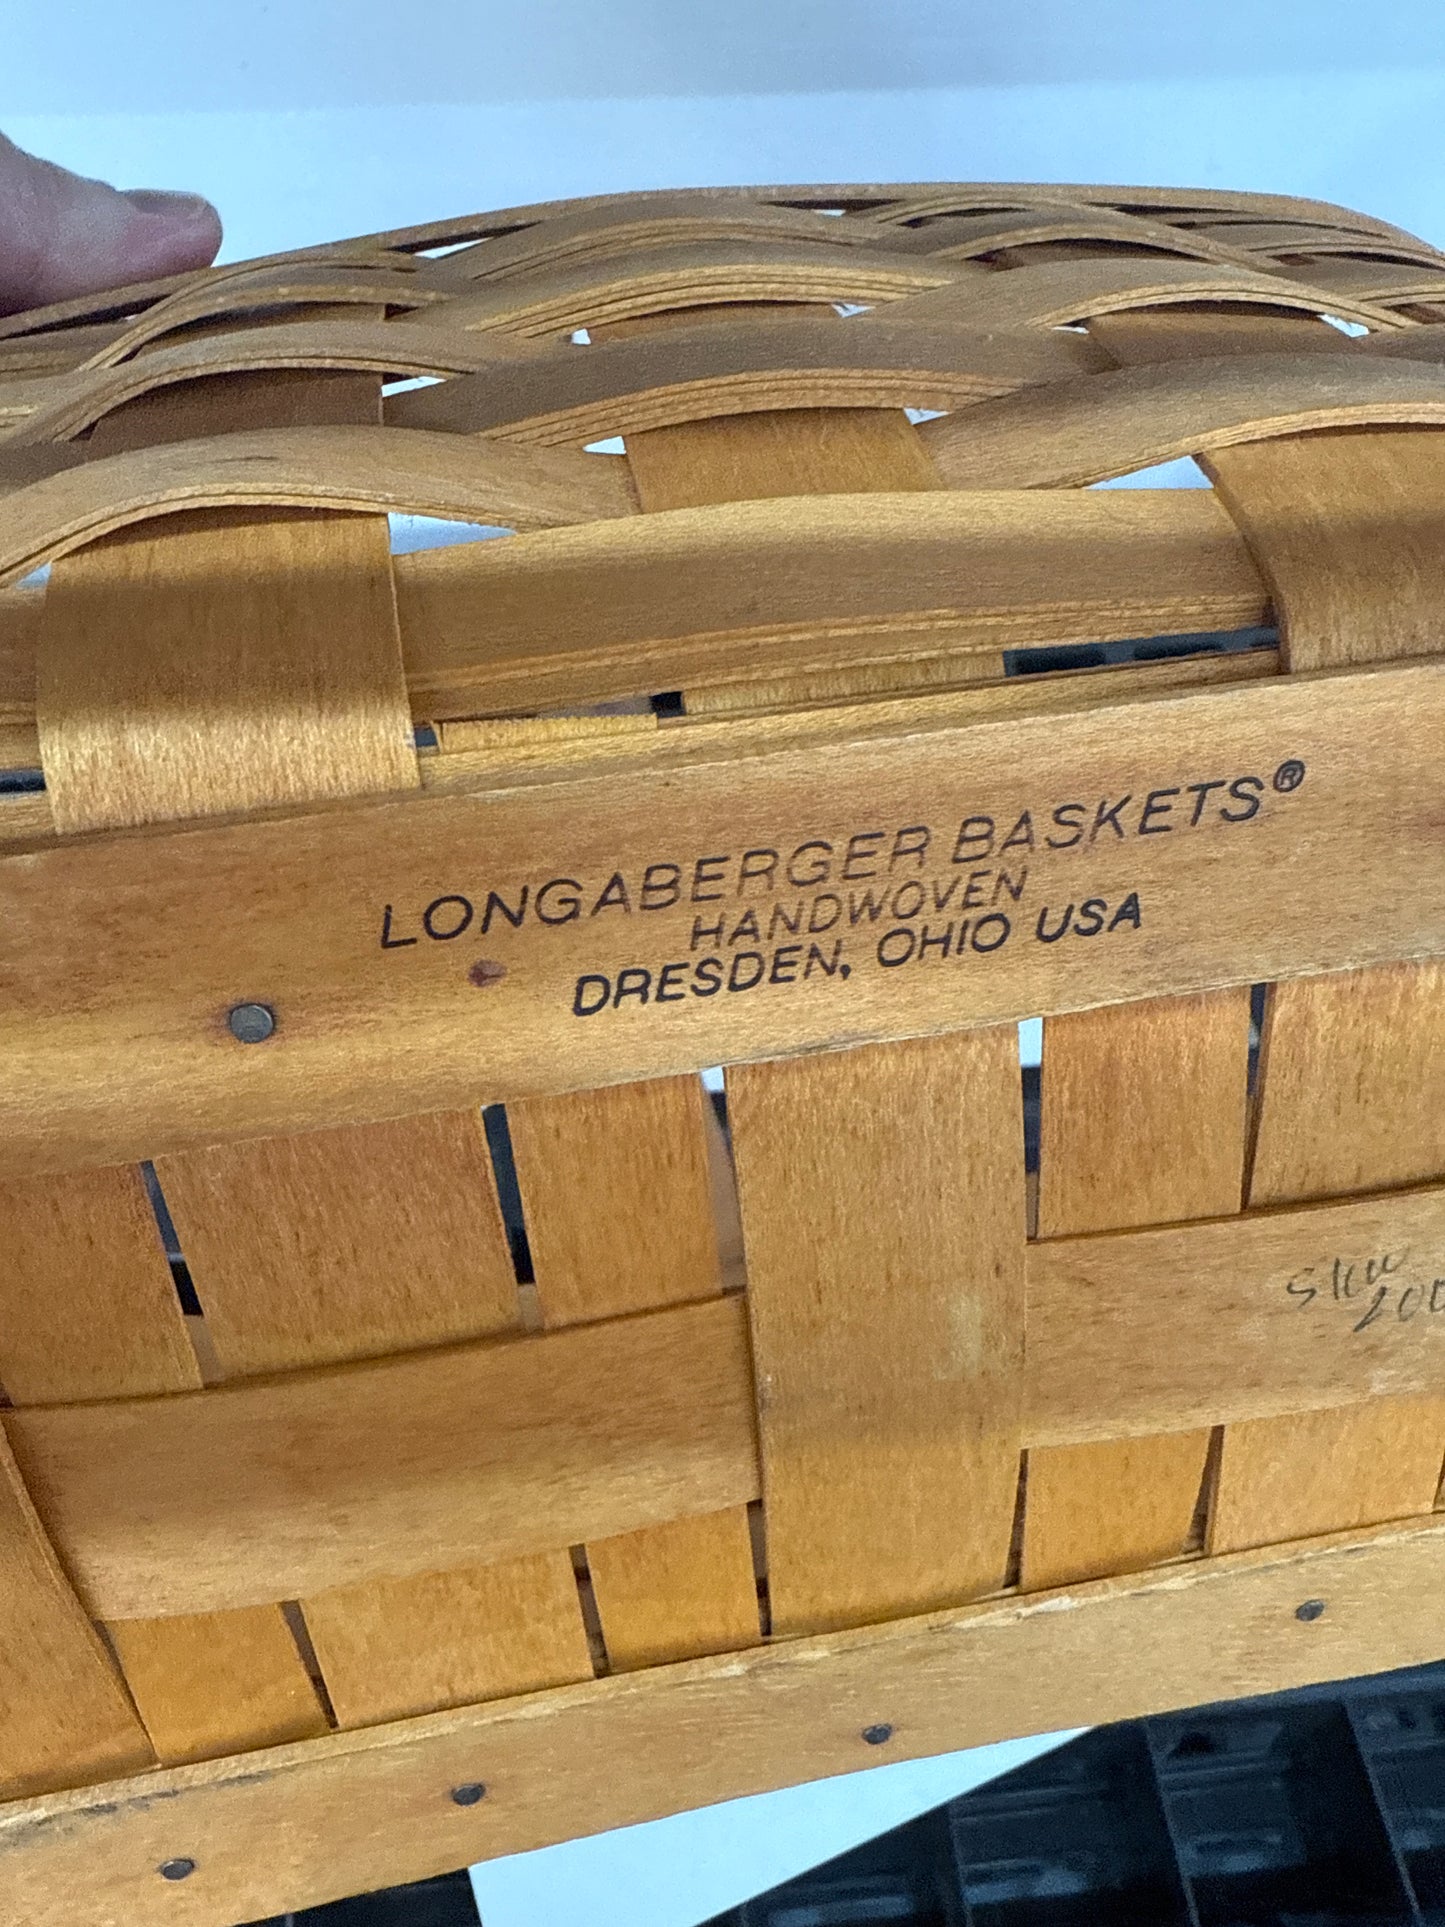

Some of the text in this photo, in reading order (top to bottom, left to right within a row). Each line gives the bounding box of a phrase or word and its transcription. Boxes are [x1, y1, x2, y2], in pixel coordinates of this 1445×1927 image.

[380, 825, 931, 949] LONGABERGER
[690, 865, 1028, 951] HANDWOVEN
[572, 892, 1142, 1017] DRESDEN, OHIO USA
